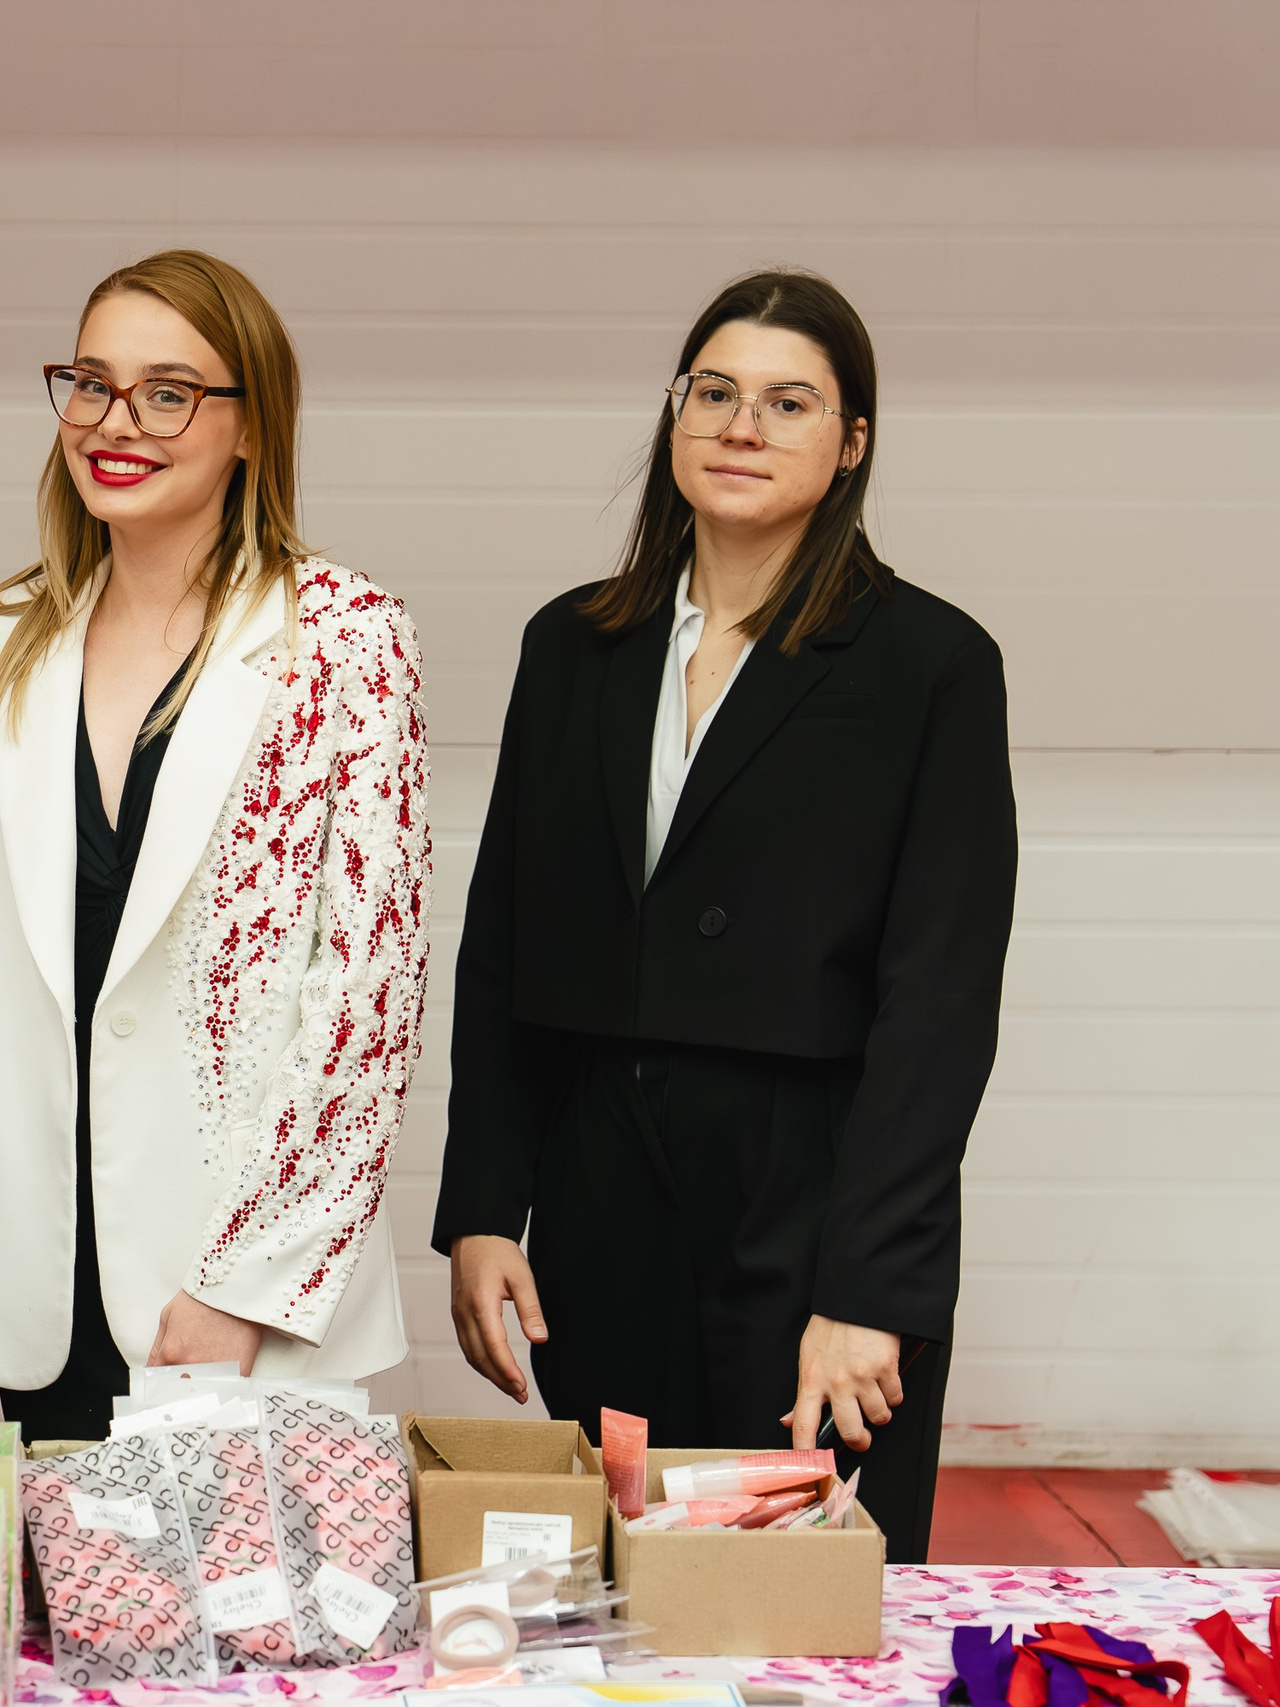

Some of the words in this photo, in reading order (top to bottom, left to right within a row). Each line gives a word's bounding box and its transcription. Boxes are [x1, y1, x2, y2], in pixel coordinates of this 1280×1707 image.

[283, 1408, 309, 1428] ch
[171, 1432, 197, 1456] ch
[228, 1431, 251, 1449] ch
[306, 1421, 332, 1443] ch
[120, 1436, 146, 1462] ch
[282, 1444, 308, 1466] ch
[329, 1437, 356, 1459] ch
[376, 1438, 398, 1460] ch
[32, 1460, 58, 1474] ch
[75, 1452, 101, 1476] ch
[208, 1450, 236, 1479] ch
[236, 1462, 263, 1487] ch
[305, 1459, 332, 1482] ch
[352, 1454, 379, 1478] ch
[57, 1472, 83, 1488] ch
[101, 1465, 127, 1488] ch
[328, 1475, 355, 1502] ch
[375, 1475, 401, 1500] ch
[37, 1484, 64, 1504] ch
[152, 1489, 176, 1511] ch
[193, 1484, 220, 1512] ch
[219, 1492, 244, 1515] ch
[281, 1484, 308, 1508] ch
[243, 1500, 269, 1525] ch
[304, 1500, 330, 1529] ch
[350, 1496, 377, 1521] ch
[43, 1516, 70, 1540] ch
[70, 1529, 96, 1551] ch
[202, 1520, 224, 1545] ch
[283, 1524, 306, 1549] ch
[326, 1522, 352, 1548] ch
[374, 1517, 400, 1542] ch
[95, 1539, 122, 1560] ch
[223, 1529, 250, 1552] ch
[249, 1540, 274, 1564] ch
[121, 1553, 148, 1573] ch
[349, 1540, 375, 1567] ch
[51, 1556, 76, 1582] ch
[76, 1565, 102, 1589] ch
[148, 1567, 176, 1588] ch
[204, 1555, 230, 1581] ch
[372, 1560, 399, 1586] ch
[101, 1575, 128, 1600] ch
[128, 1588, 156, 1611] ch
[58, 1595, 83, 1622] ch
[84, 1604, 110, 1632] ch
[153, 1600, 180, 1626] ch
[128, 1624, 155, 1653] ch
[214, 1634, 242, 1660] ch
[262, 1621, 289, 1650] ch
[111, 1652, 136, 1681] ch
[152, 1647, 176, 1678] ch
